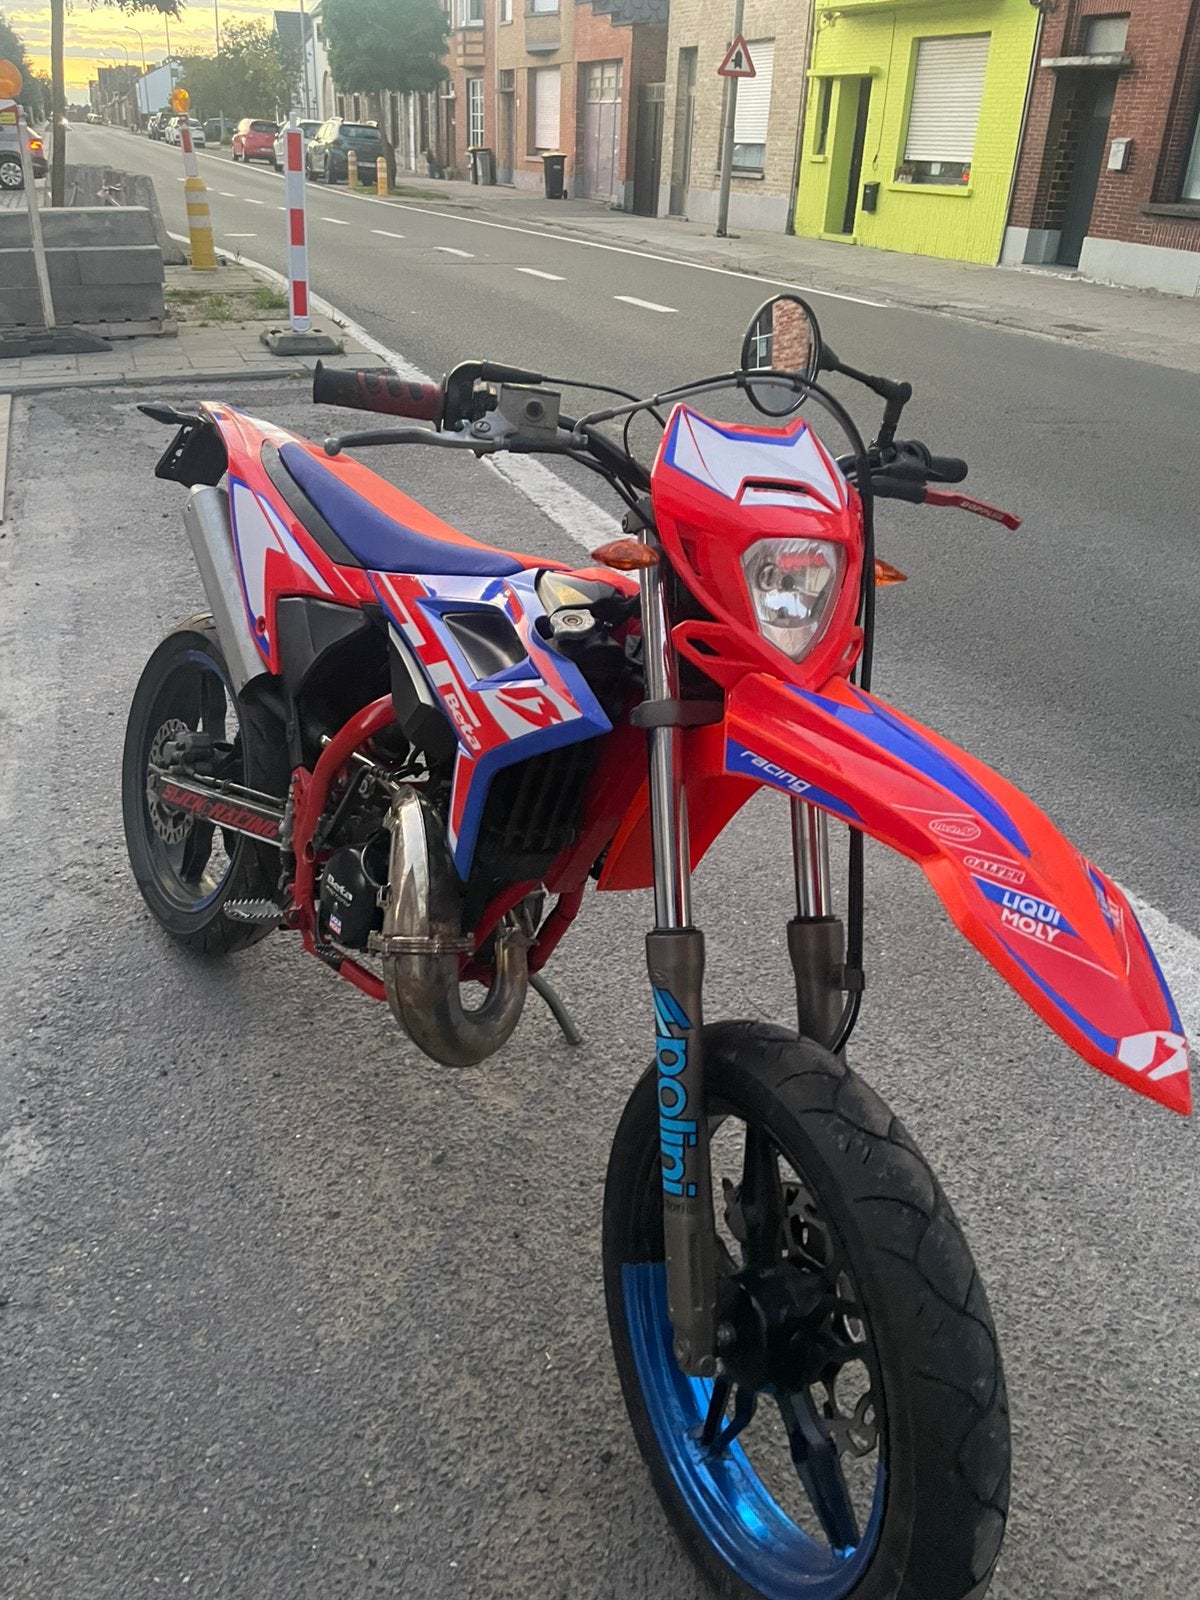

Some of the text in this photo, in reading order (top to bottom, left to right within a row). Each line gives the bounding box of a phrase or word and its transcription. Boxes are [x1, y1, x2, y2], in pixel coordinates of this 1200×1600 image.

[443, 693, 482, 750] Beta
[740, 750, 812, 793] racing
[206, 802, 279, 838] RACING
[327, 873, 353, 901] Beta
[965, 856, 1024, 883] GALFER
[1001, 891, 1062, 925] LIQUI
[1001, 908, 1061, 942] MOLY
[656, 1036, 698, 1197] polini
